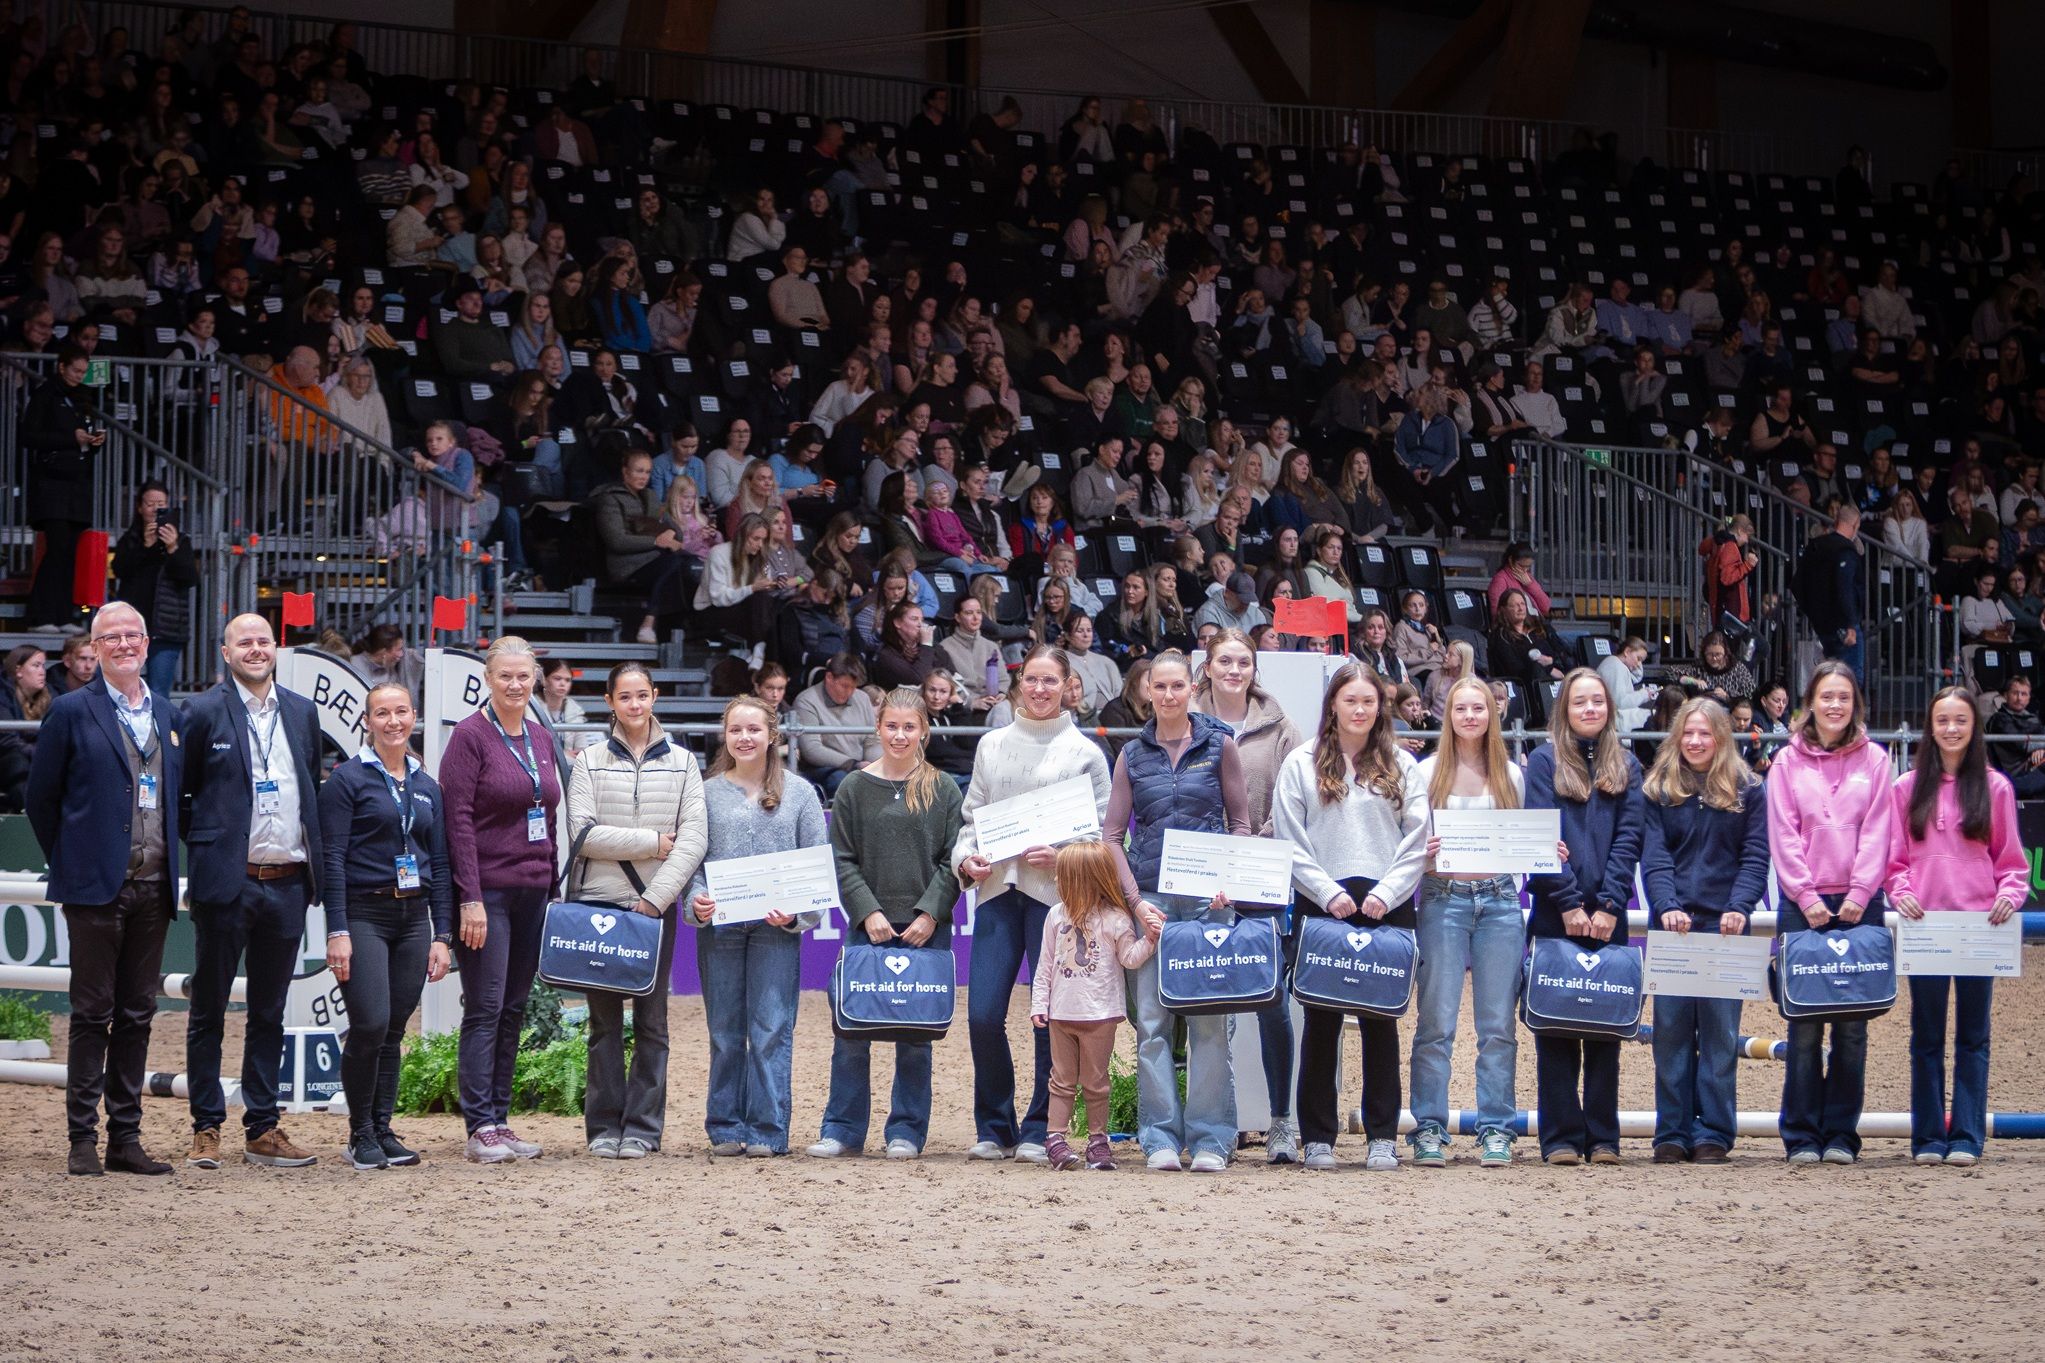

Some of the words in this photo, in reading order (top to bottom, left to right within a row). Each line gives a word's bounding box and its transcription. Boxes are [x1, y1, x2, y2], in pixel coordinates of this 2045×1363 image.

[1072, 823, 1087, 832] Agria
[1260, 890, 1276, 898] Agria
[812, 898, 826, 906] Agria
[550, 936, 577, 950] First
[578, 940, 597, 953] aid
[598, 942, 616, 955] for
[618, 944, 650, 960] horse
[1168, 958, 1194, 970] First
[1196, 956, 1214, 968] aid
[1216, 954, 1232, 966] for
[1234, 953, 1268, 965] horse
[1306, 952, 1332, 967] First
[1334, 957, 1352, 970] aid
[1354, 959, 1372, 972] for
[1372, 962, 1405, 978] horse
[1792, 964, 1820, 976] First
[1820, 962, 1838, 974] aid
[1840, 962, 1858, 974] for
[1858, 962, 1889, 972] horse
[850, 981, 876, 992] First
[878, 981, 894, 992] aid
[896, 981, 914, 992] for
[916, 982, 948, 992] horse
[1538, 974, 1566, 988] First
[1566, 978, 1583, 990] aid
[1585, 979, 1602, 991] for
[1604, 980, 1634, 995] horse
[316, 1042, 332, 1072] 6
[306, 1081, 344, 1092] LONGINE
